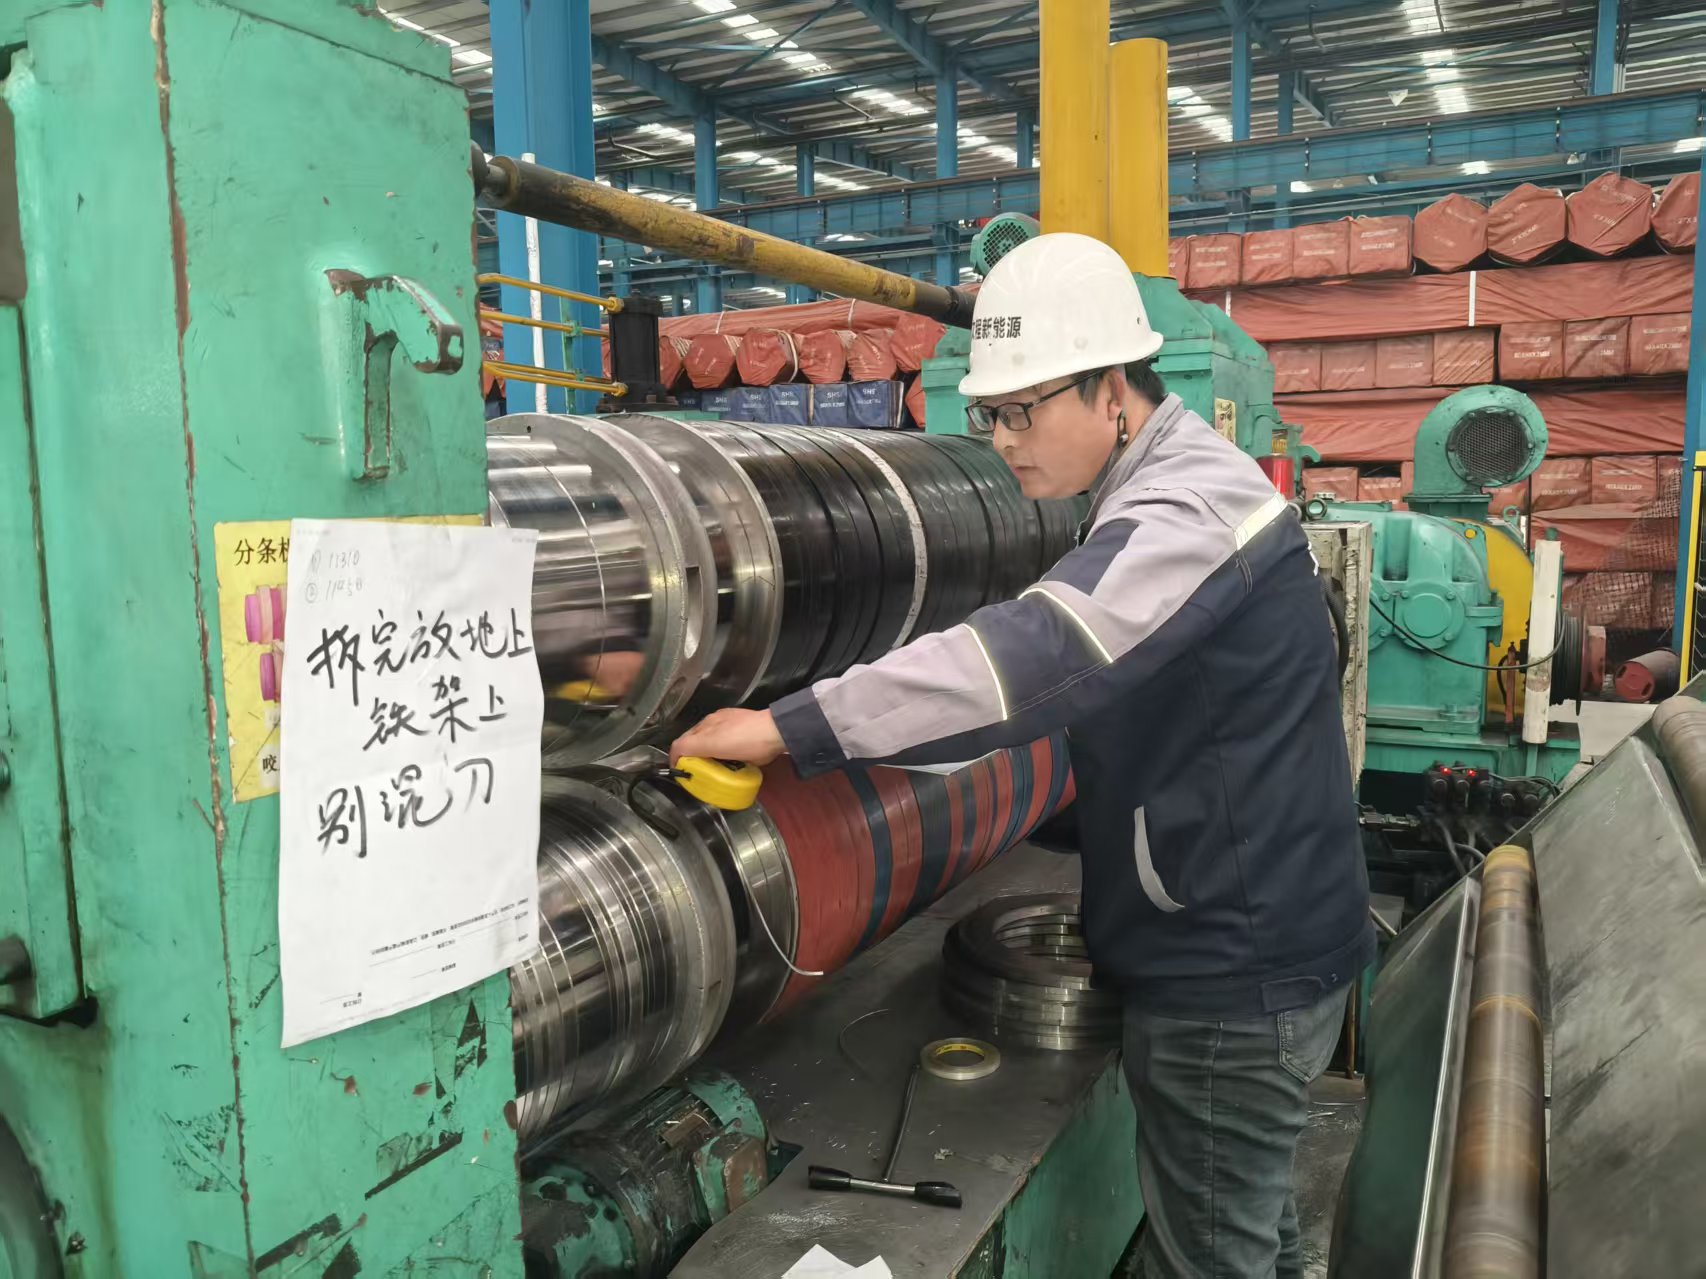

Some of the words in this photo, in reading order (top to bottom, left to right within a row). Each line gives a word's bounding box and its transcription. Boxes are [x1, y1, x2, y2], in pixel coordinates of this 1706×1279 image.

[363, 675, 507, 750] 铁架上
[317, 754, 494, 859] 别混刀
